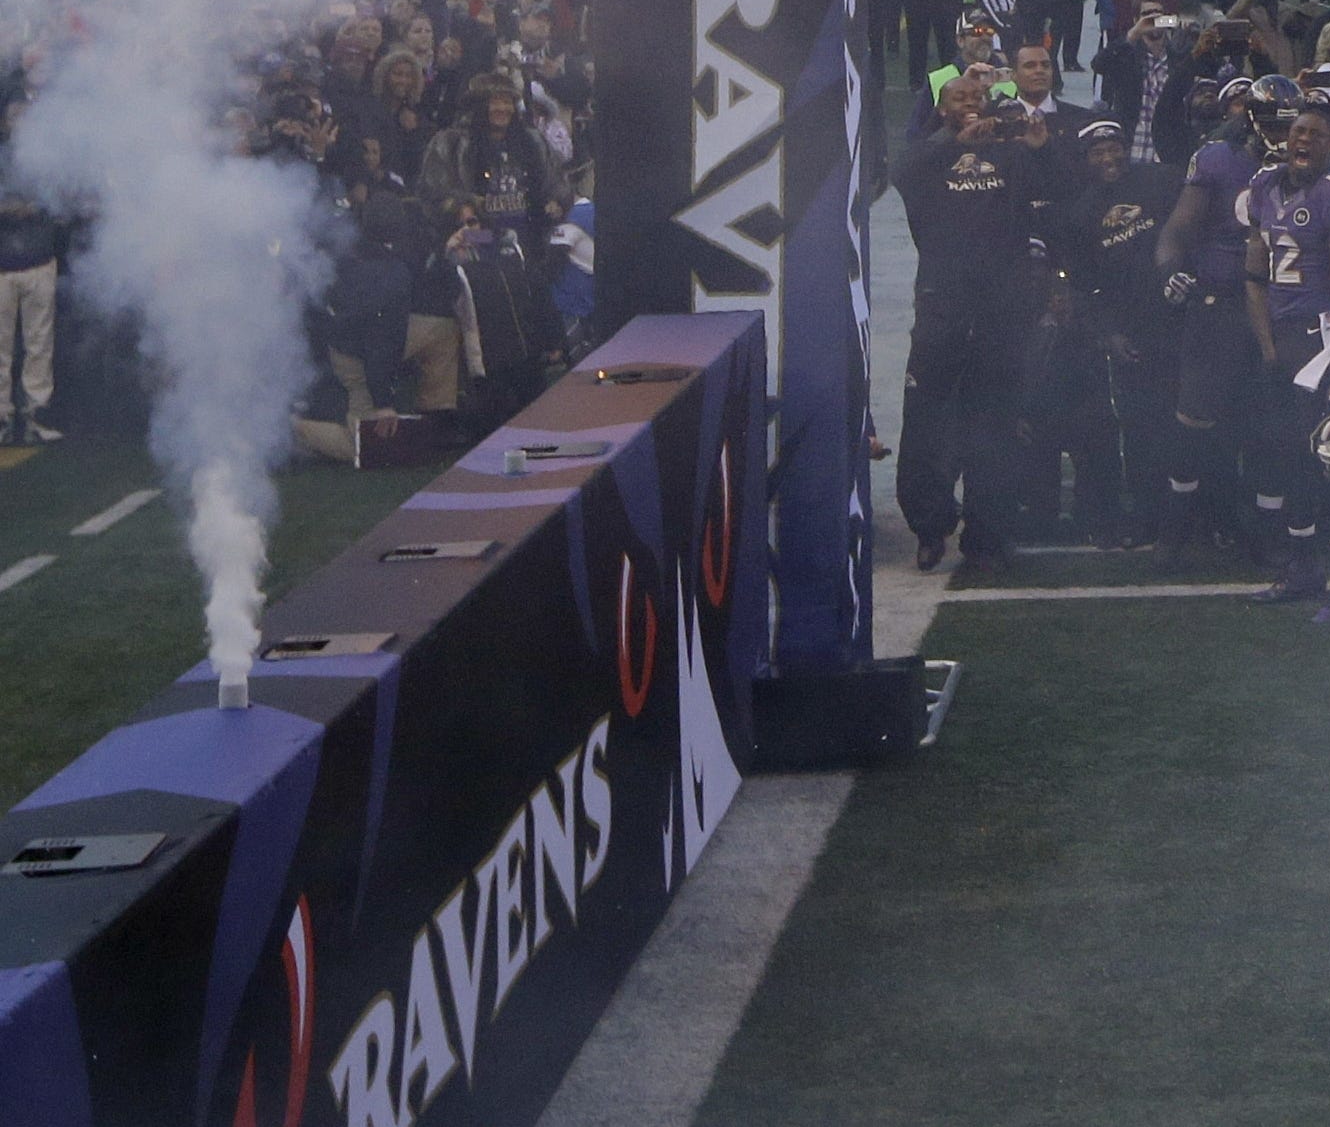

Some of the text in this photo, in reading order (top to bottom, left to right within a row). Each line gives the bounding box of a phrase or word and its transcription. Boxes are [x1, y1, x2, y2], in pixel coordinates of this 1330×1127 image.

[1102, 218, 1155, 248] RAVENS
[1261, 230, 1301, 283] 12
[328, 714, 612, 1127] RAVENS
